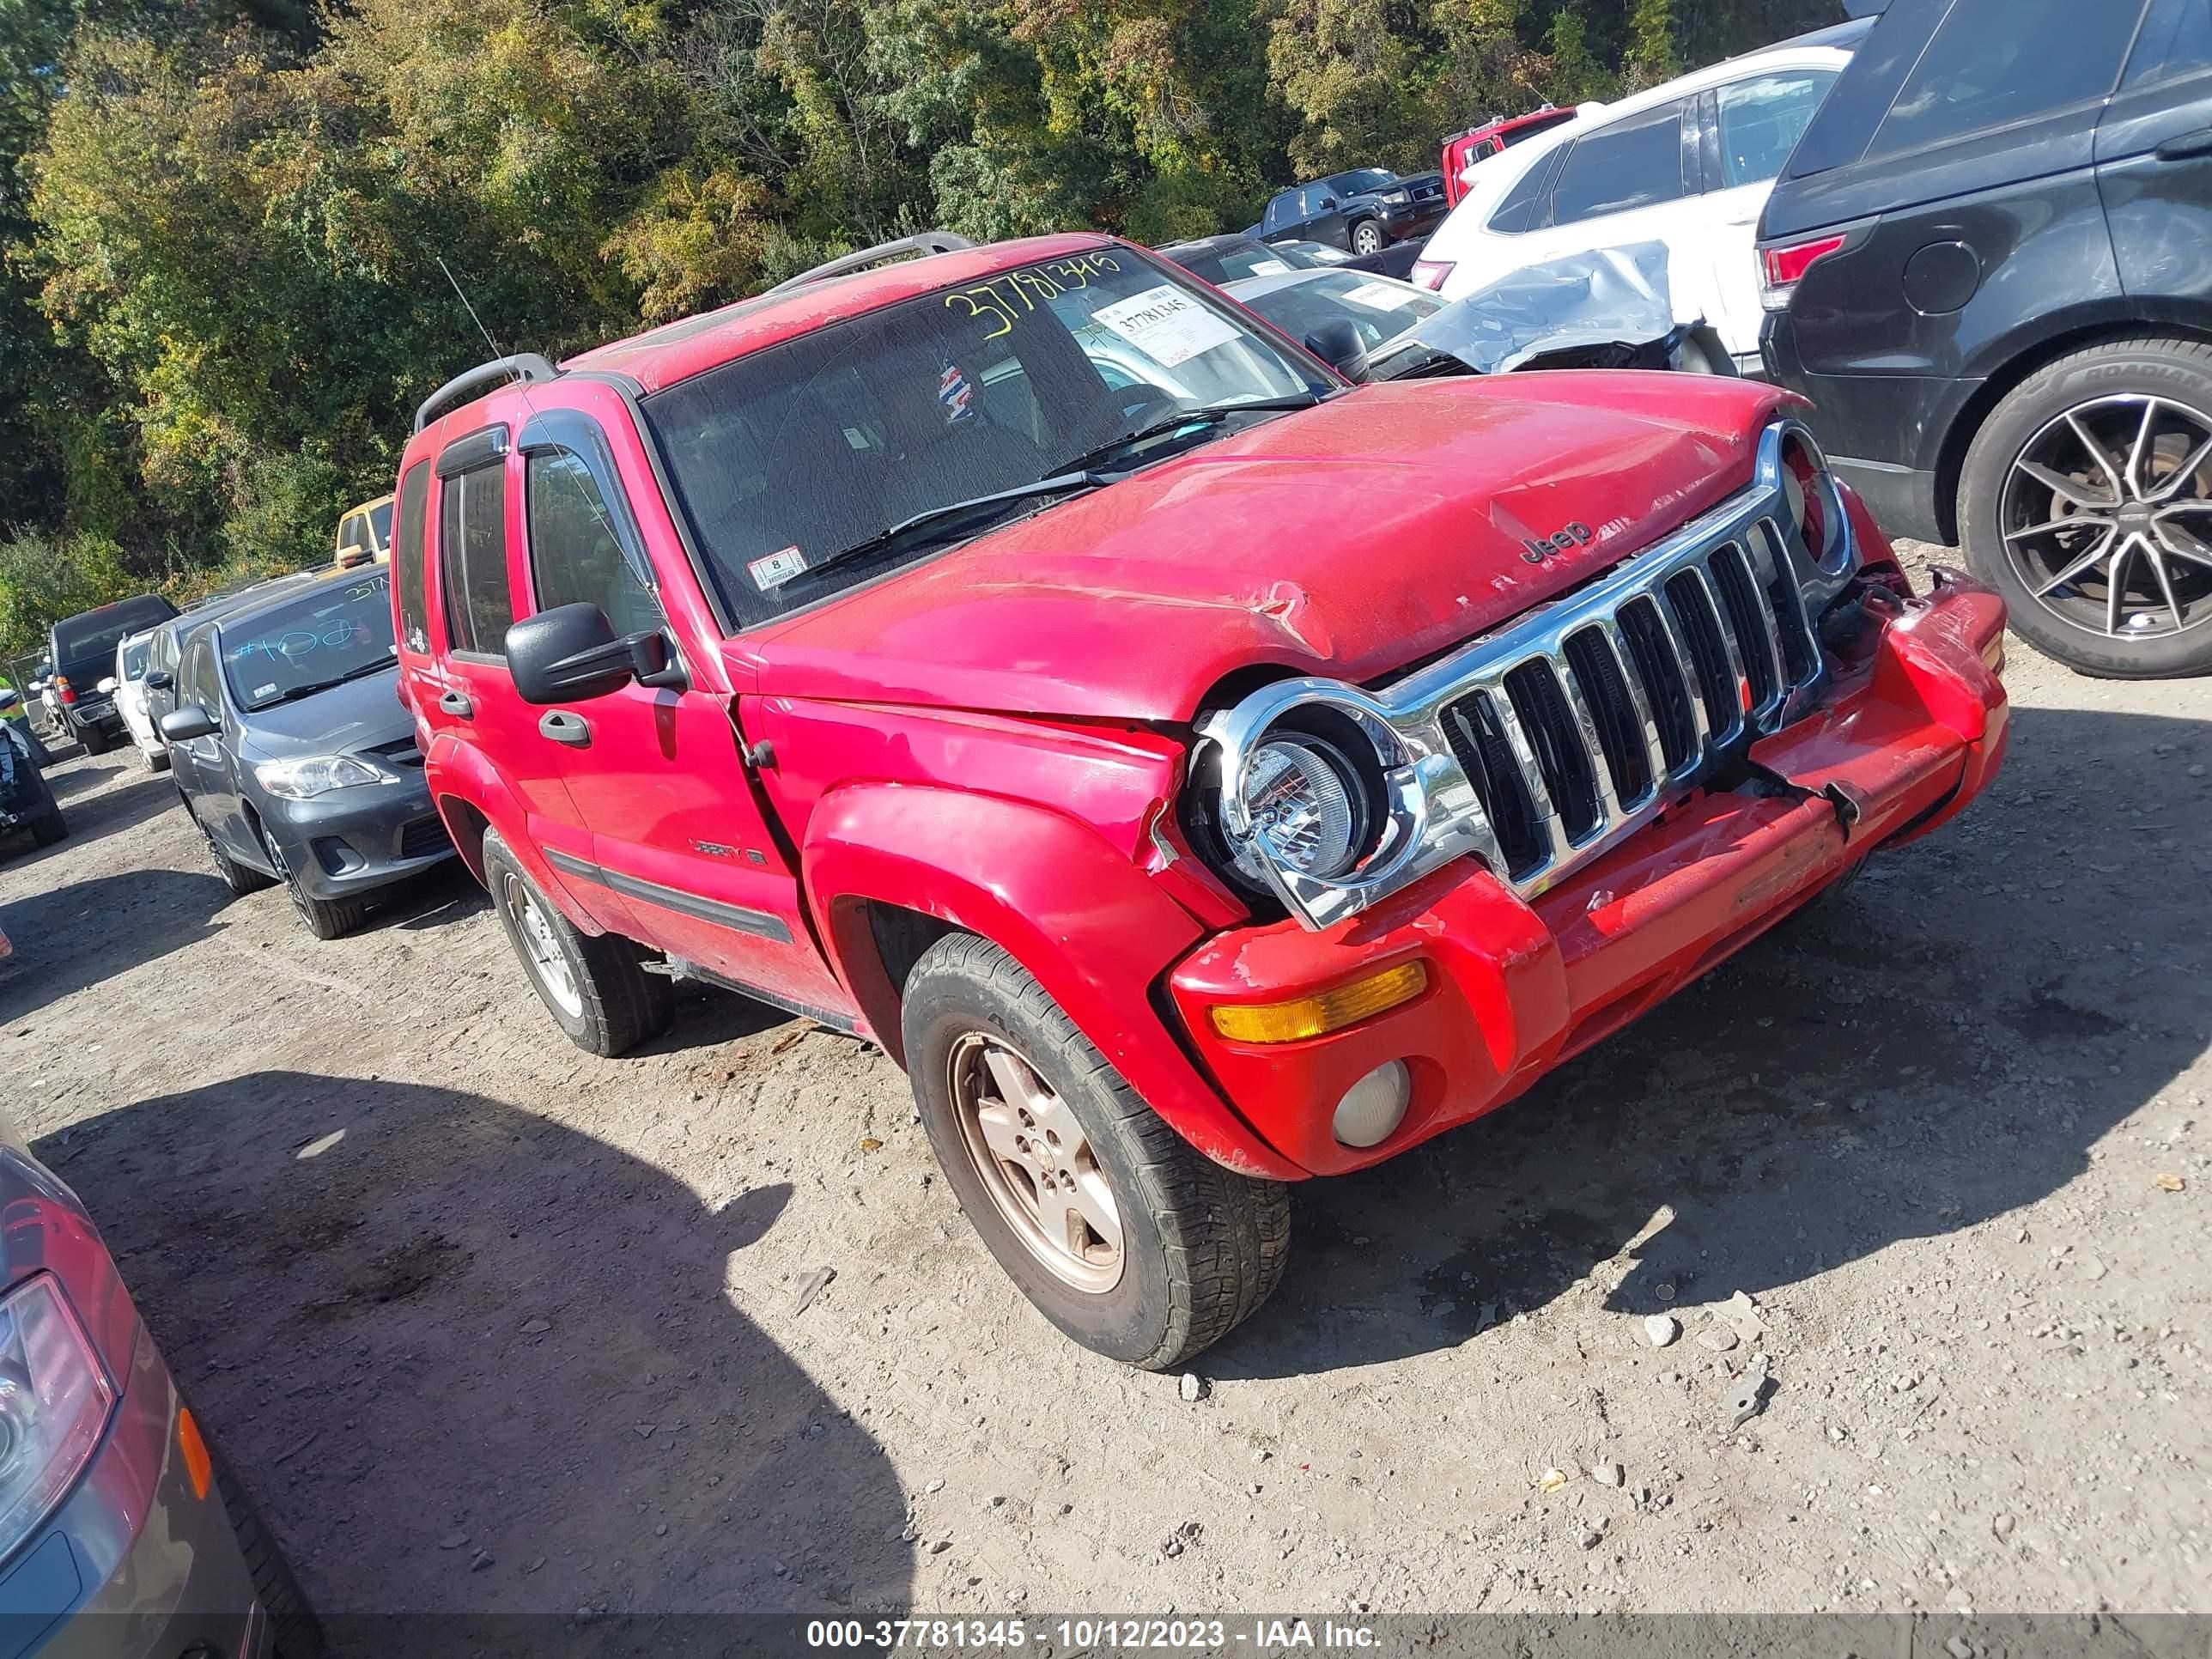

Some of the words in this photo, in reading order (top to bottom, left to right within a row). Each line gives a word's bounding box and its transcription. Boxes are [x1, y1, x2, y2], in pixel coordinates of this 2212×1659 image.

[945, 252, 1120, 341] 37781345
[1120, 299, 1188, 332] 37781345
[1520, 521, 1591, 564] Jeep
[772, 560, 781, 569] 8
